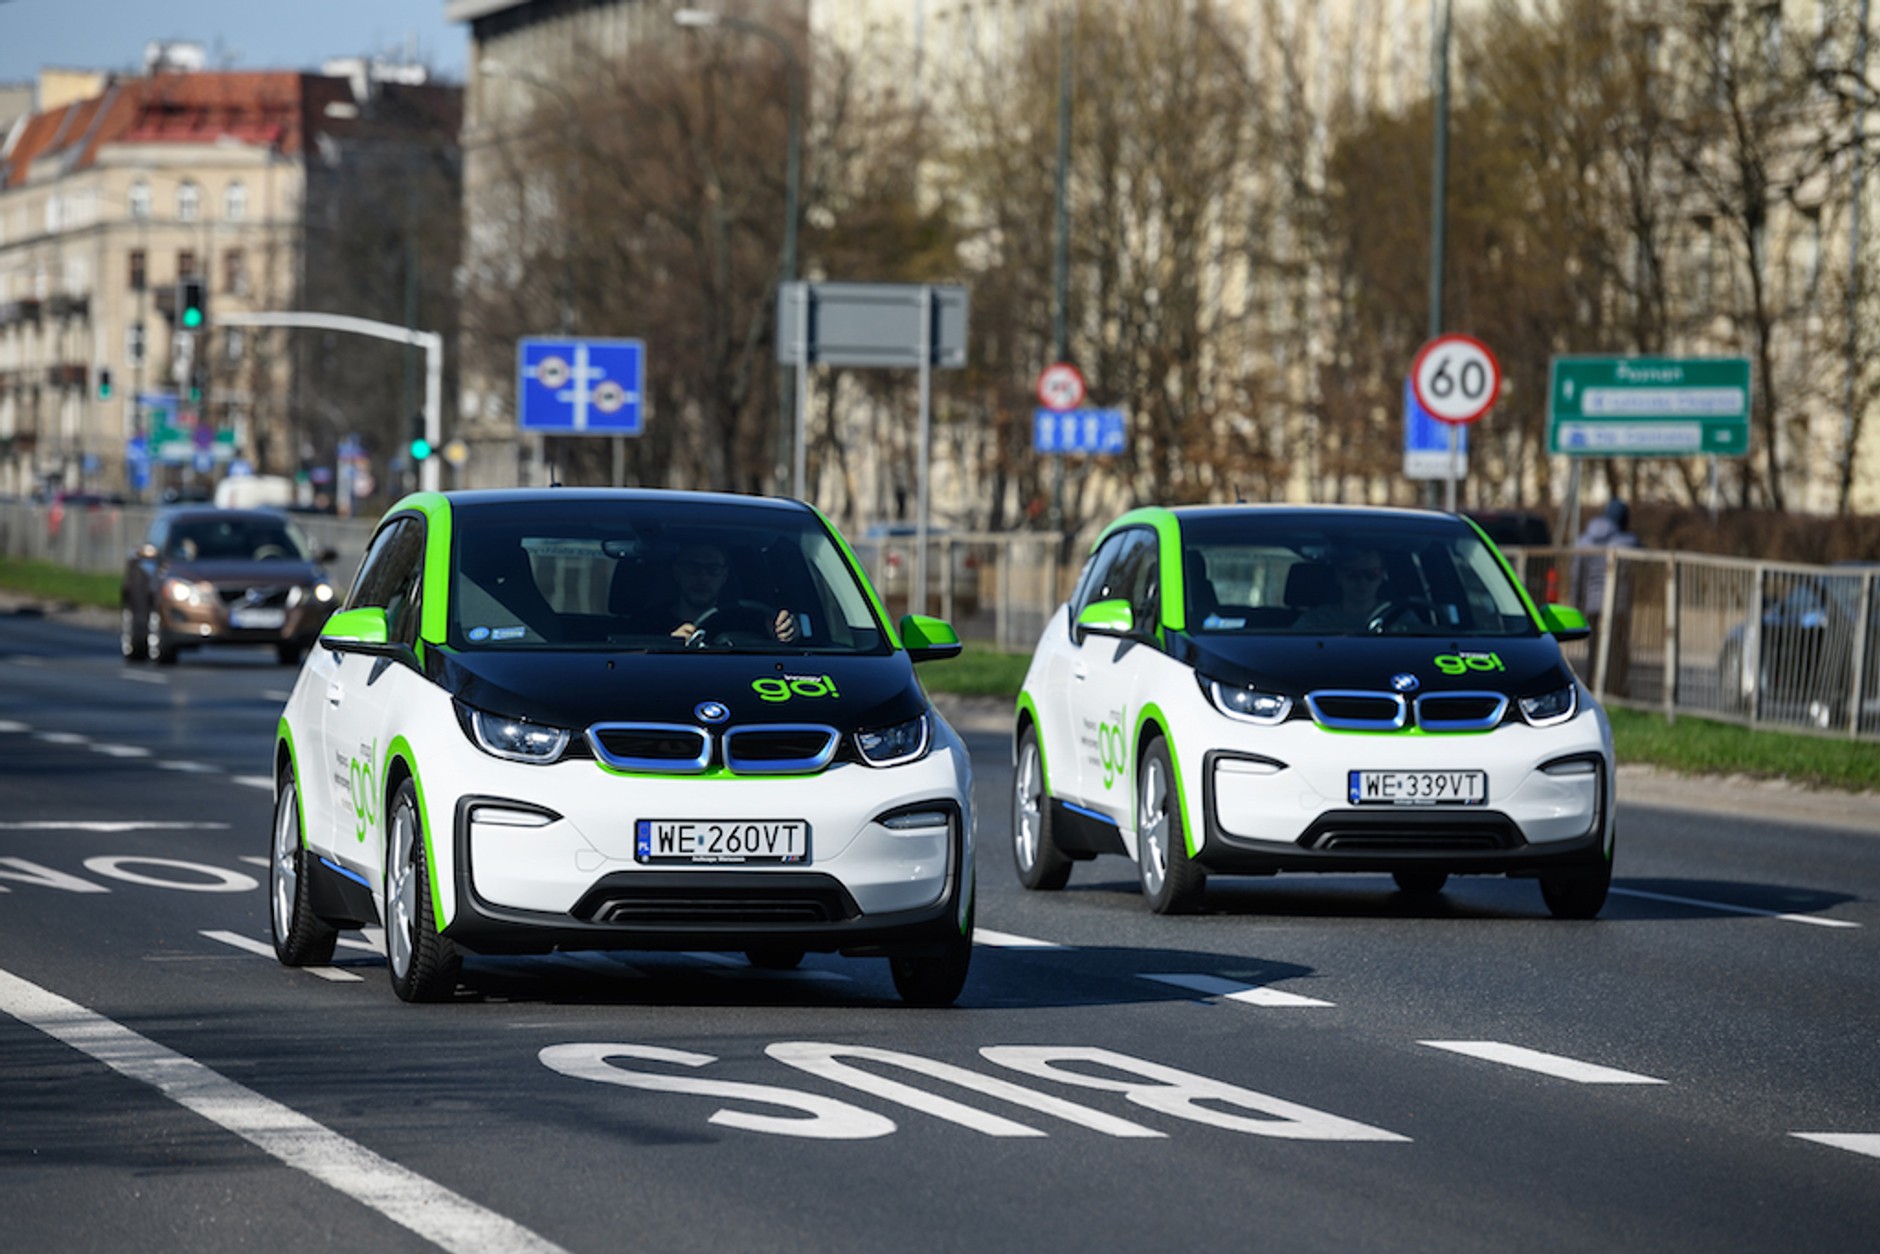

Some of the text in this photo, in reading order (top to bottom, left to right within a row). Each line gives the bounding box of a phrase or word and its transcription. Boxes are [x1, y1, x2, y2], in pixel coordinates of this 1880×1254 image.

[1430, 354, 1486, 400] 60
[1433, 652, 1505, 675] go!
[751, 674, 840, 702] go!
[1366, 774, 1478, 797] WE 339VT
[658, 825, 799, 853] WE 260VT
[538, 1042, 1413, 1141] BUS
